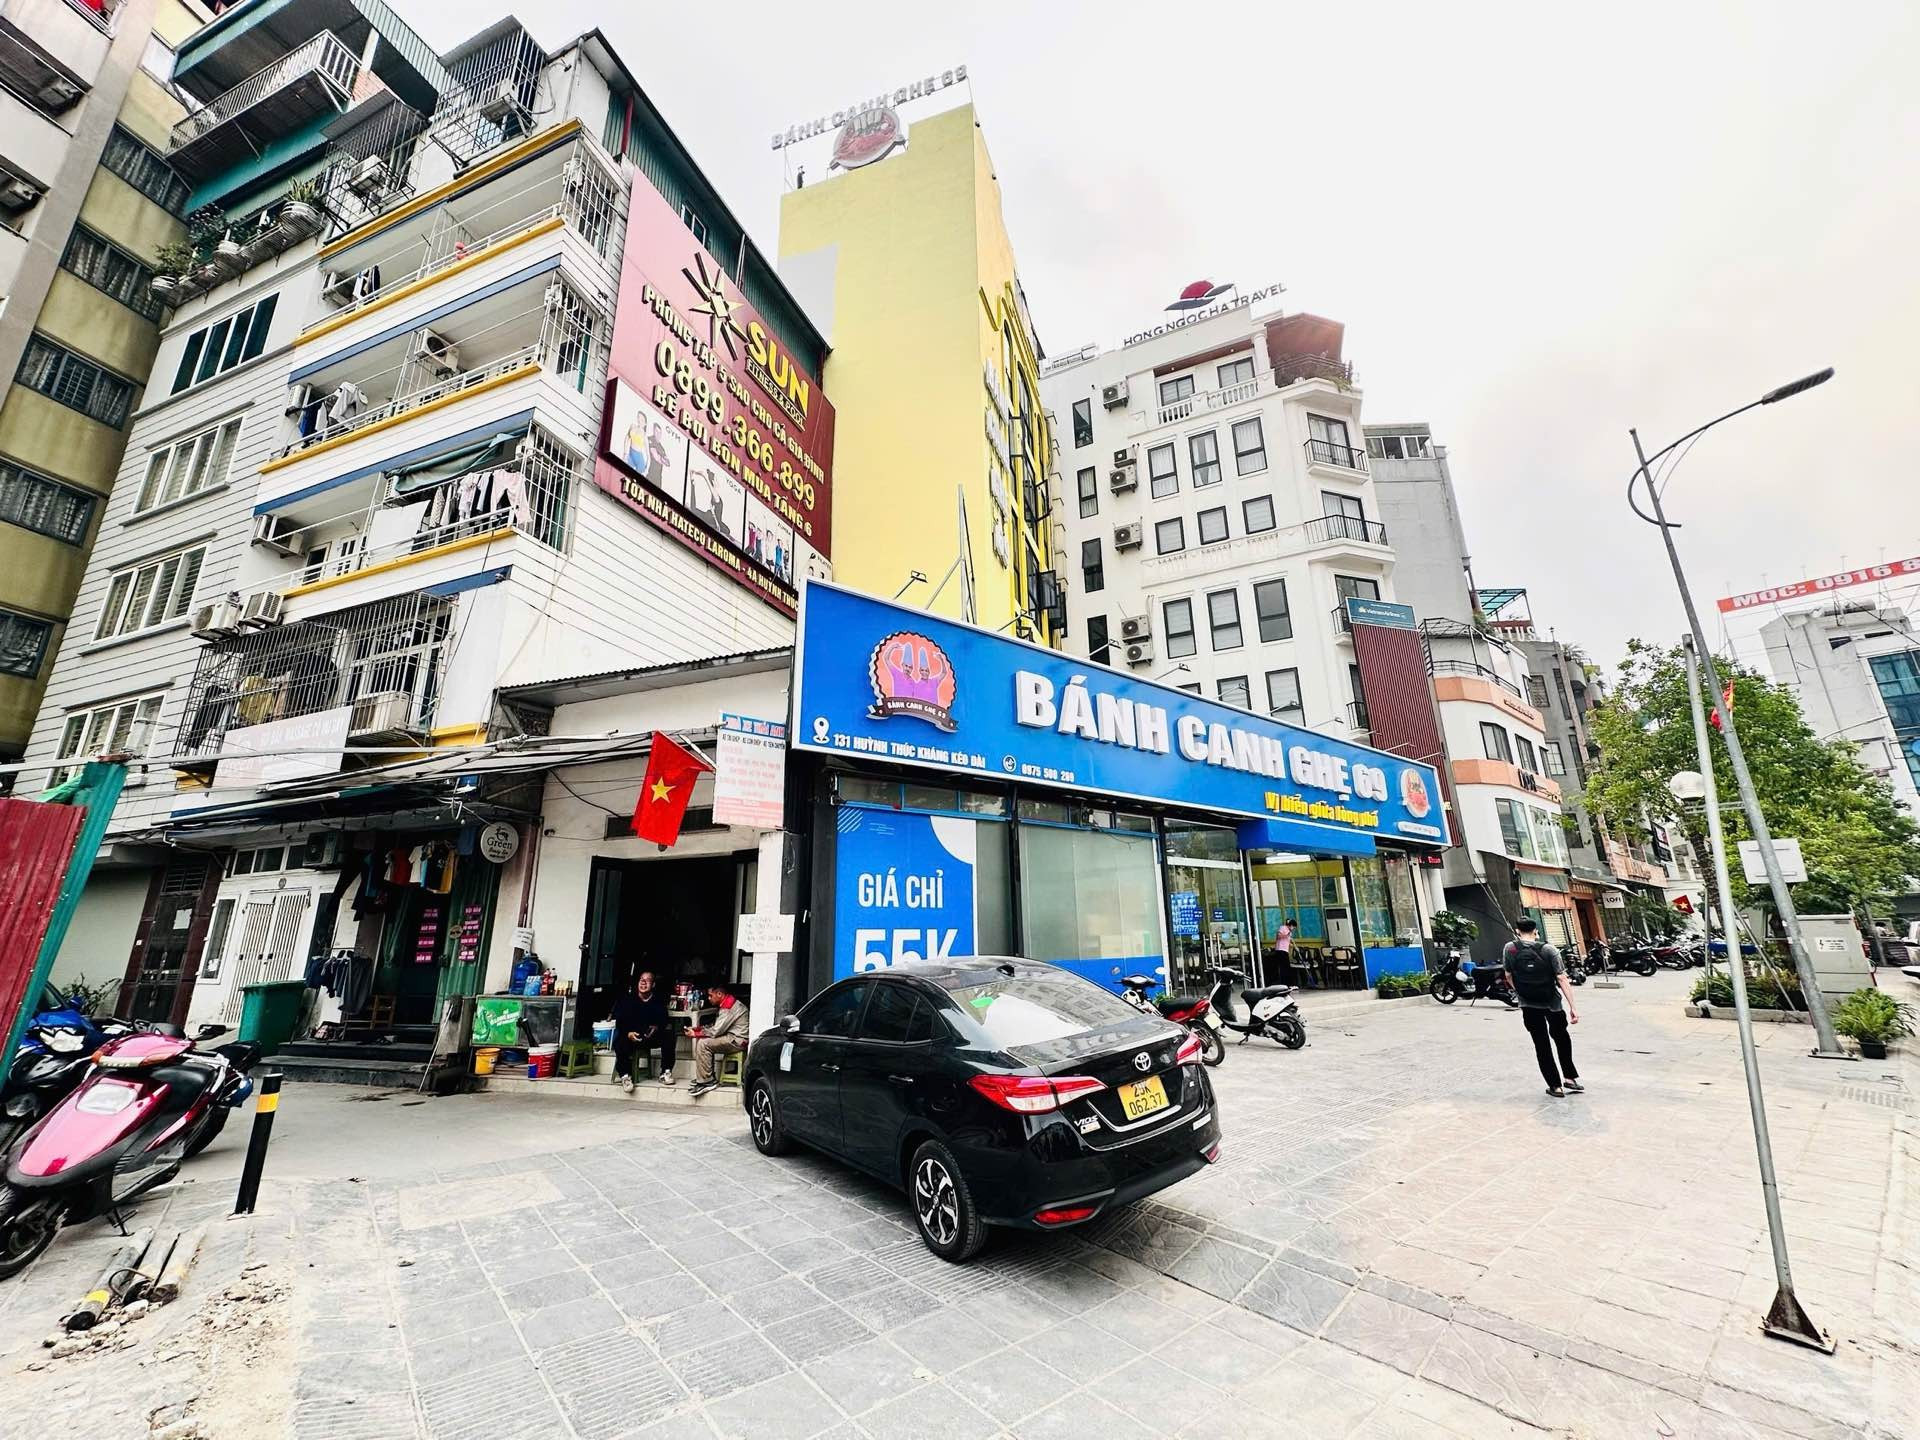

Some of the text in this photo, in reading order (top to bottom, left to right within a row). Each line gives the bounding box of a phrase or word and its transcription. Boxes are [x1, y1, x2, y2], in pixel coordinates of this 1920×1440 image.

[771, 117, 826, 151] BÁNH
[1229, 282, 1288, 310] TRAVEL
[746, 321, 809, 418] SUN
[747, 358, 778, 398] FITNESS
[785, 401, 804, 426] POOL
[717, 364, 728, 384] 5
[728, 376, 751, 407] SAO
[751, 399, 773, 430] CHO
[787, 437, 804, 463] GIA
[665, 426, 681, 443] GYM
[726, 477, 742, 495] YOGA
[742, 465, 771, 503] MÙA
[804, 521, 813, 537] 6
[670, 510, 706, 546] HATECO
[707, 537, 741, 571] LAROMA
[747, 566, 758, 583] 4A
[758, 575, 782, 600] HUỲNH
[1815, 565, 1893, 591] 0916
[833, 734, 851, 748] 131
[853, 736, 888, 754] HUỲNH
[891, 743, 916, 758] THÚC
[917, 746, 949, 763] KHÁNG
[951, 751, 969, 766] KÉO
[1015, 669, 1388, 802] BÁNH CANH GHẸ 69
[1264, 791, 1280, 813] Vị
[486, 836, 513, 849] Green
[858, 866, 944, 909] GIÁ CHỈ
[1606, 896, 1621, 904] LOFI
[1129, 1092, 1163, 1116] 062.37
[1073, 1114, 1099, 1127] VIOS
